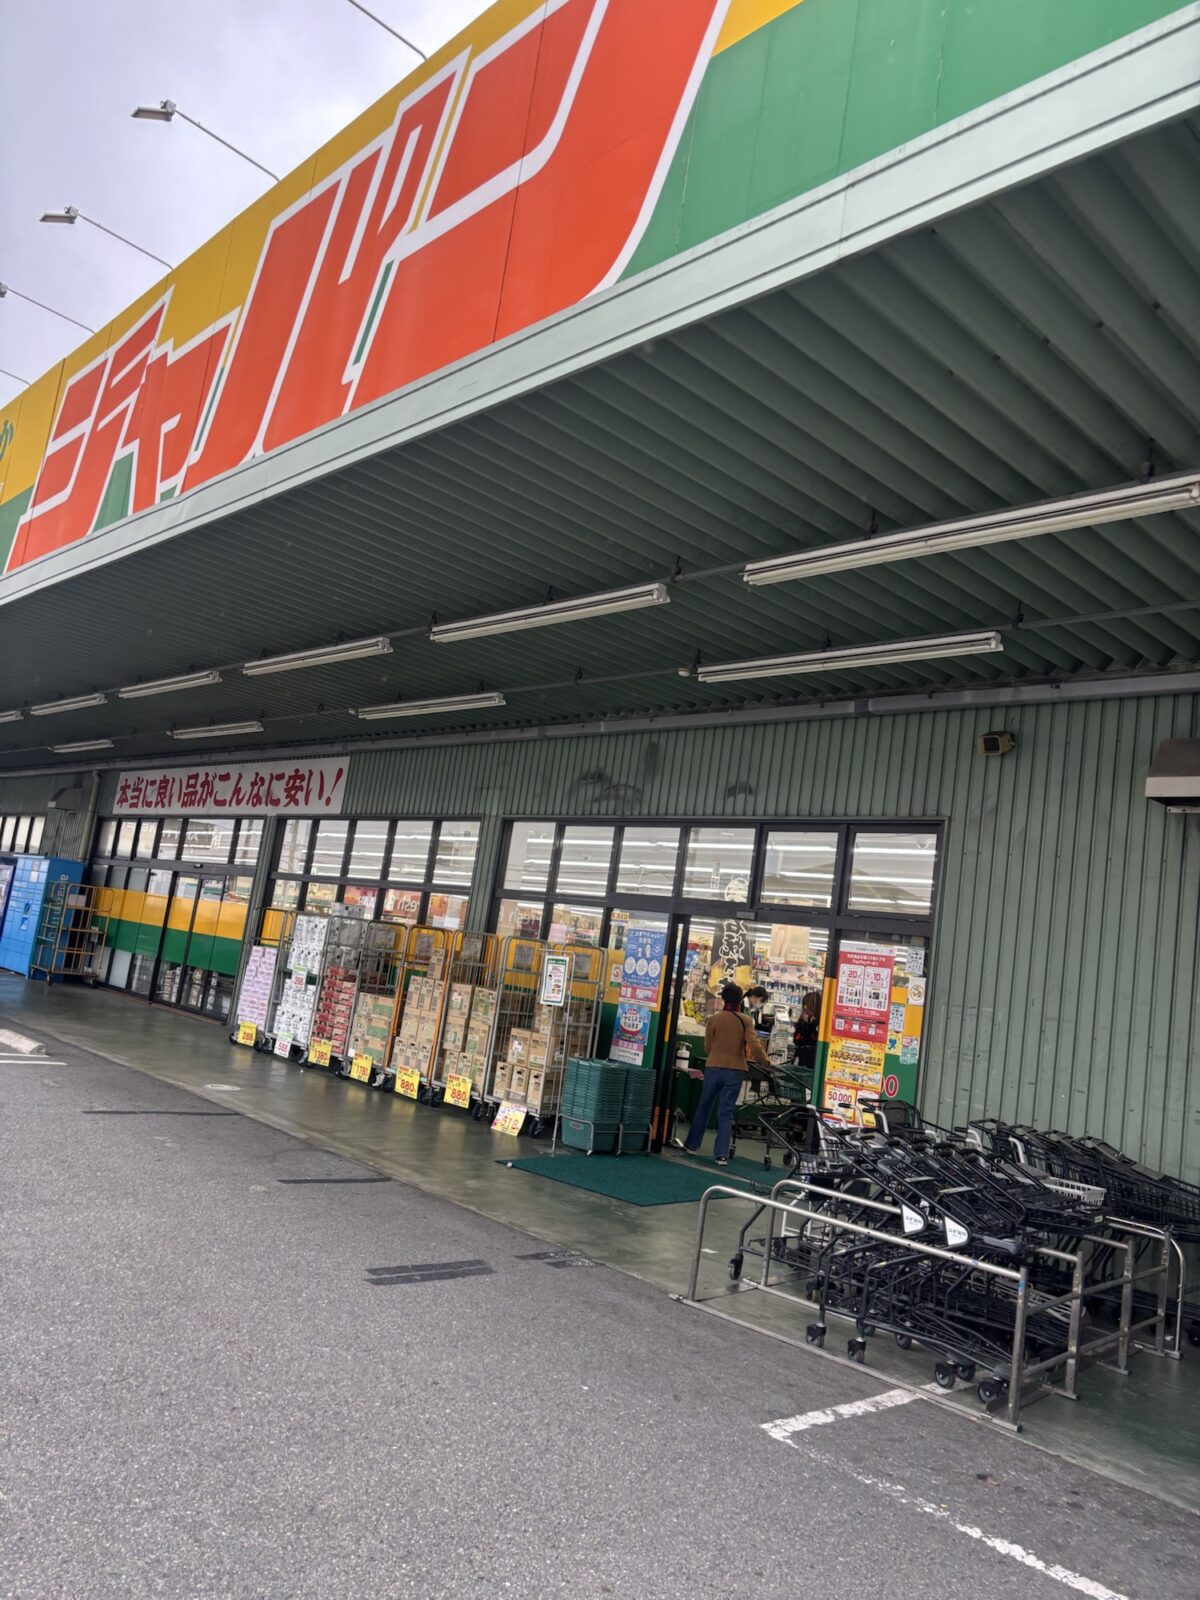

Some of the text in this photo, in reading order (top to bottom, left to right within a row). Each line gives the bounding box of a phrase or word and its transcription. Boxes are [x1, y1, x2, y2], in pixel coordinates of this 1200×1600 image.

[400, 1079, 414, 1093] 880
[450, 1088, 467, 1102] 880
[501, 1115, 519, 1130] 518
